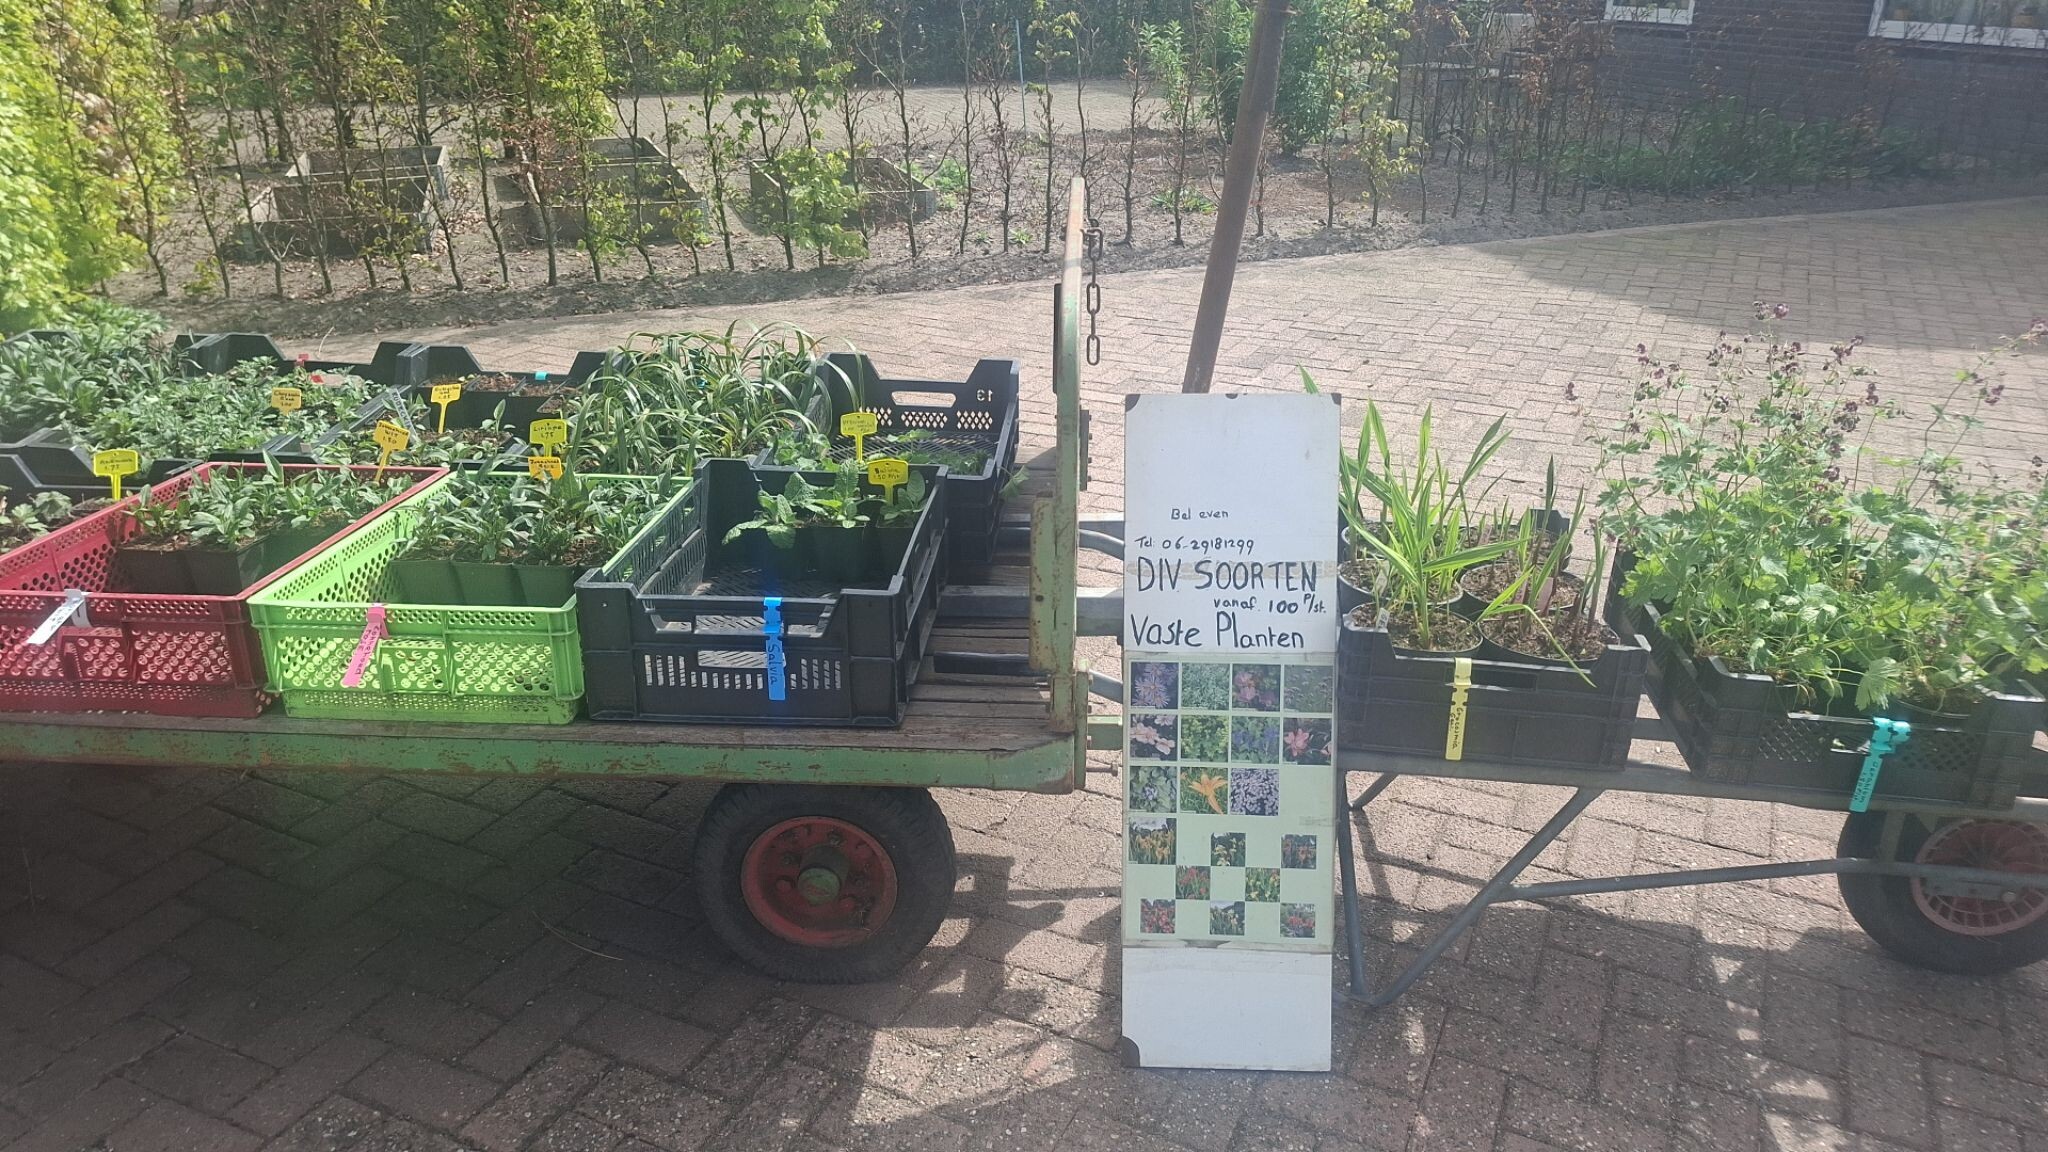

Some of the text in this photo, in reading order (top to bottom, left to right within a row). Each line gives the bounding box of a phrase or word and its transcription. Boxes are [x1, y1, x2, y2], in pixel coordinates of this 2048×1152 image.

[1171, 507, 1230, 520] Bel even
[1194, 557, 1318, 592] SOORTEN
[1268, 599, 1299, 614] 100
[1131, 610, 1305, 649] Vaste Planten
[768, 643, 781, 686] Salvia
